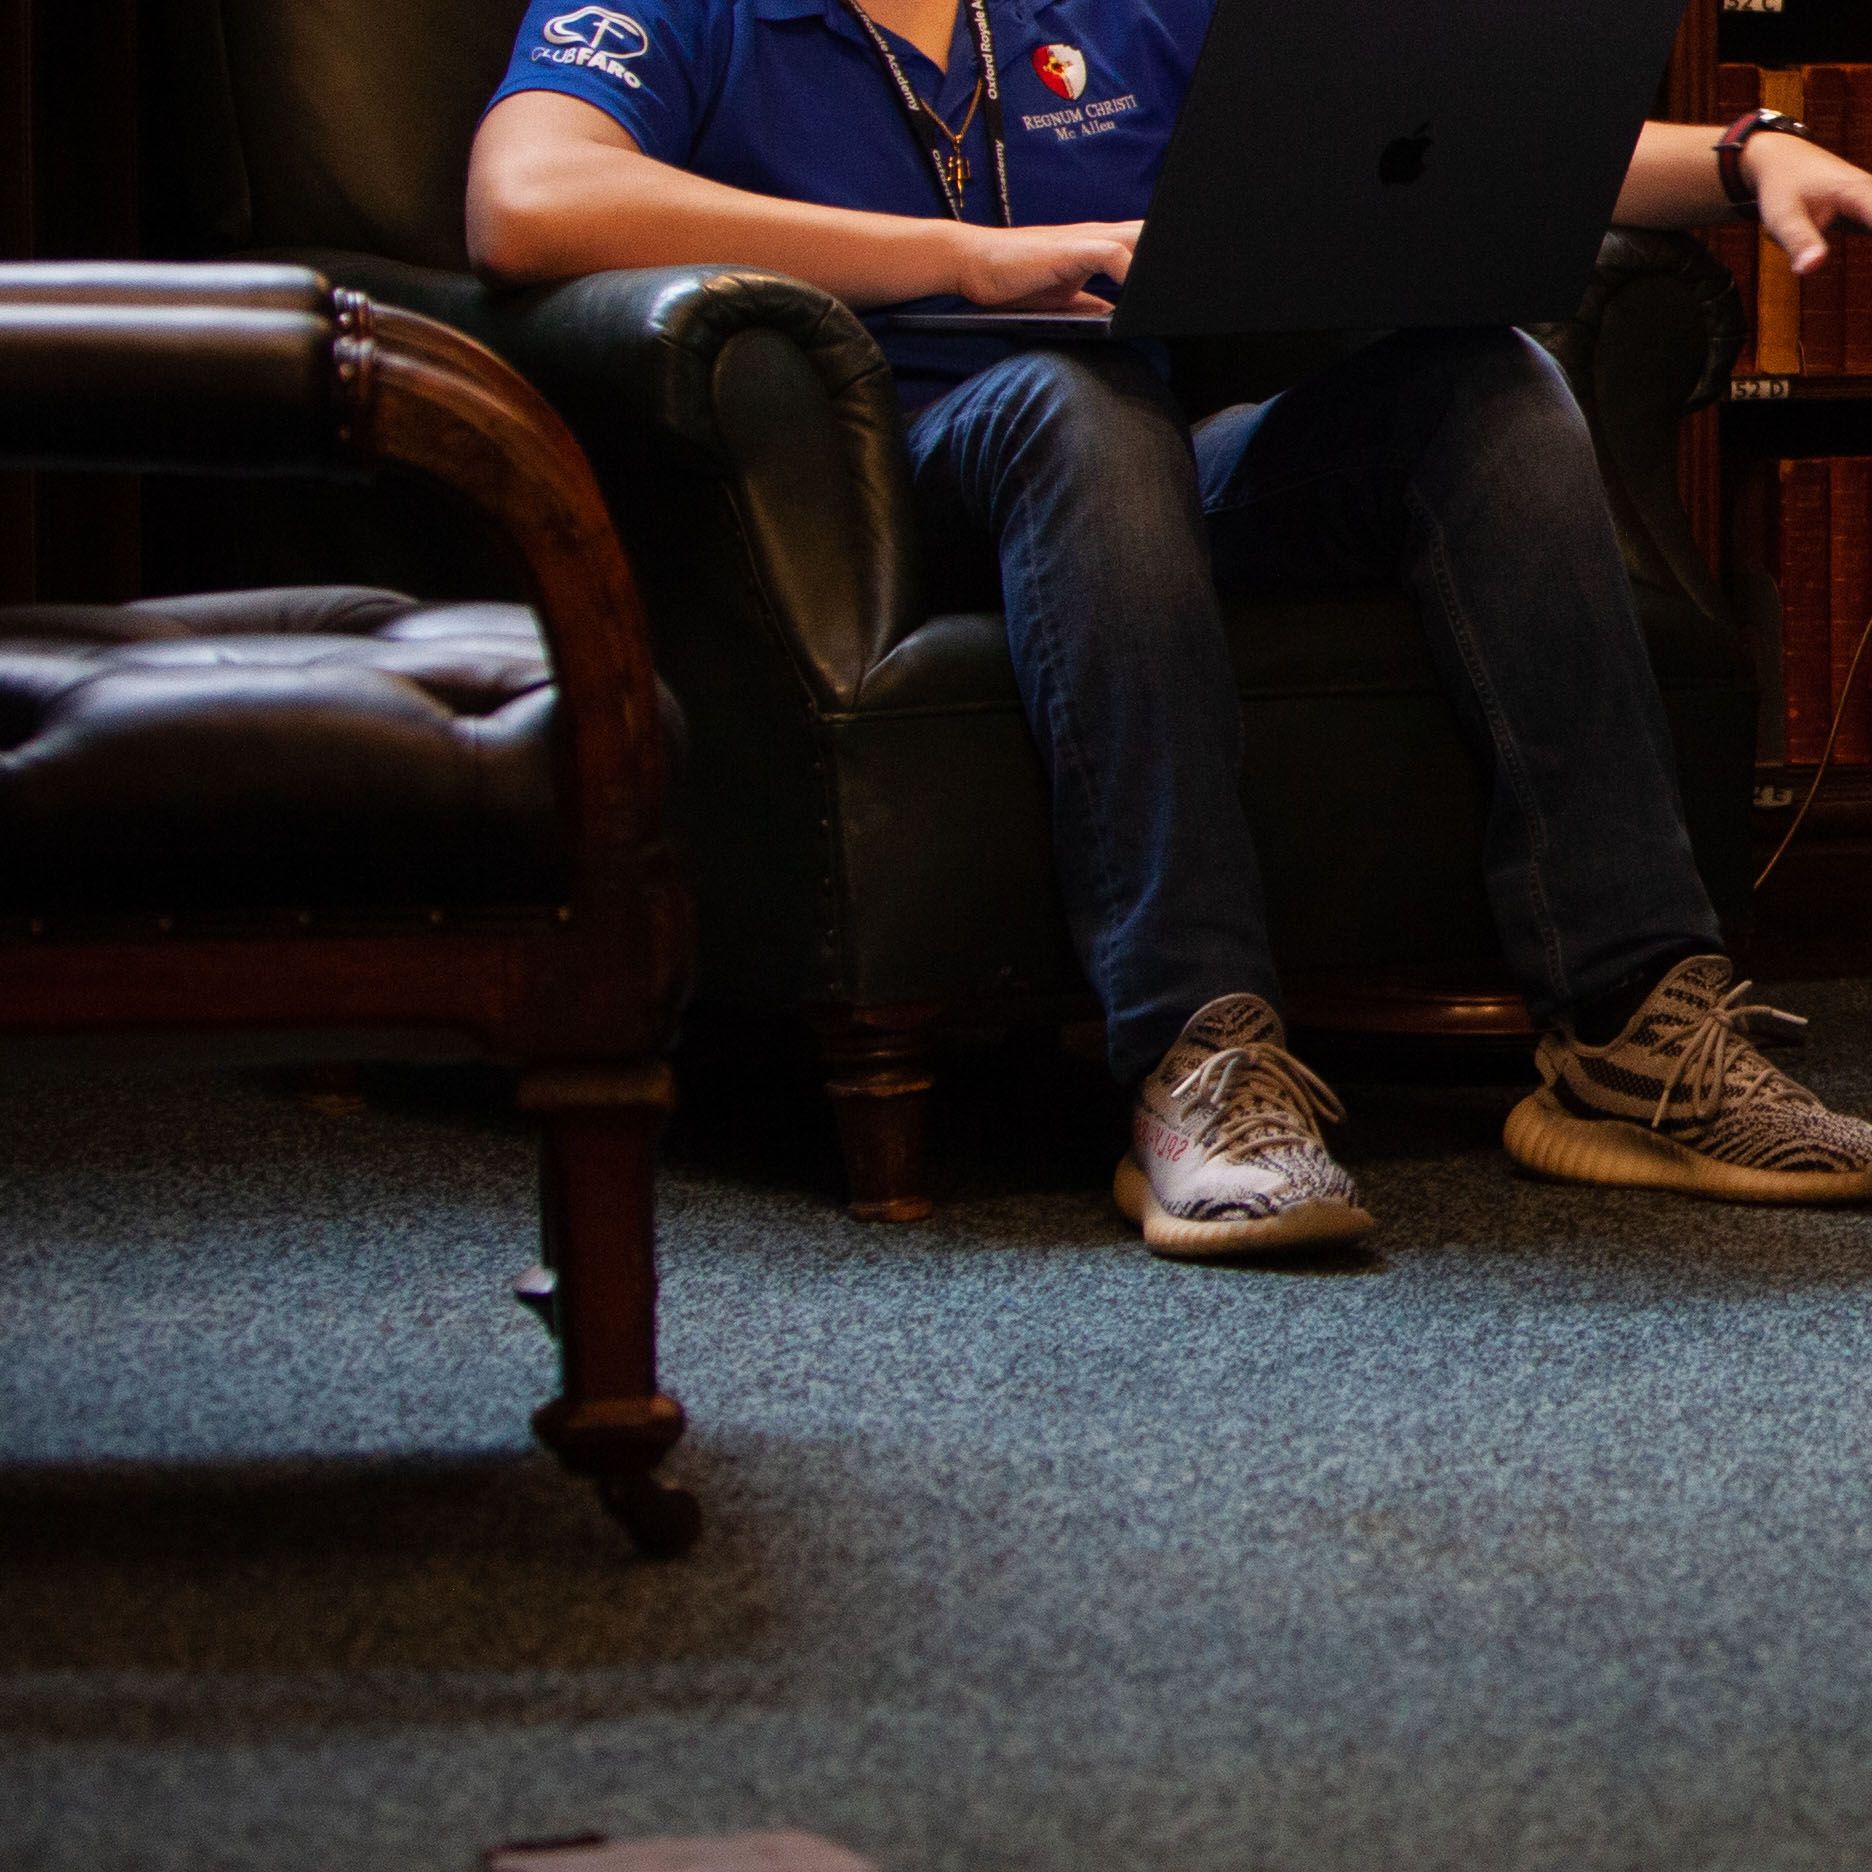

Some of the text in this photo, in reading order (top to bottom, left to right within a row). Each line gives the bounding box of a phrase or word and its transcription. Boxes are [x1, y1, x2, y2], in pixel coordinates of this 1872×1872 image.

[973, 10, 992, 53] Royale
[885, 51, 921, 112] Academy
[982, 54, 998, 101] Oxford
[1022, 94, 1138, 131] REGNUM CHRISTI
[1053, 119, 1116, 142] Mc Allen
[1736, 381, 1783, 397] 52 D
